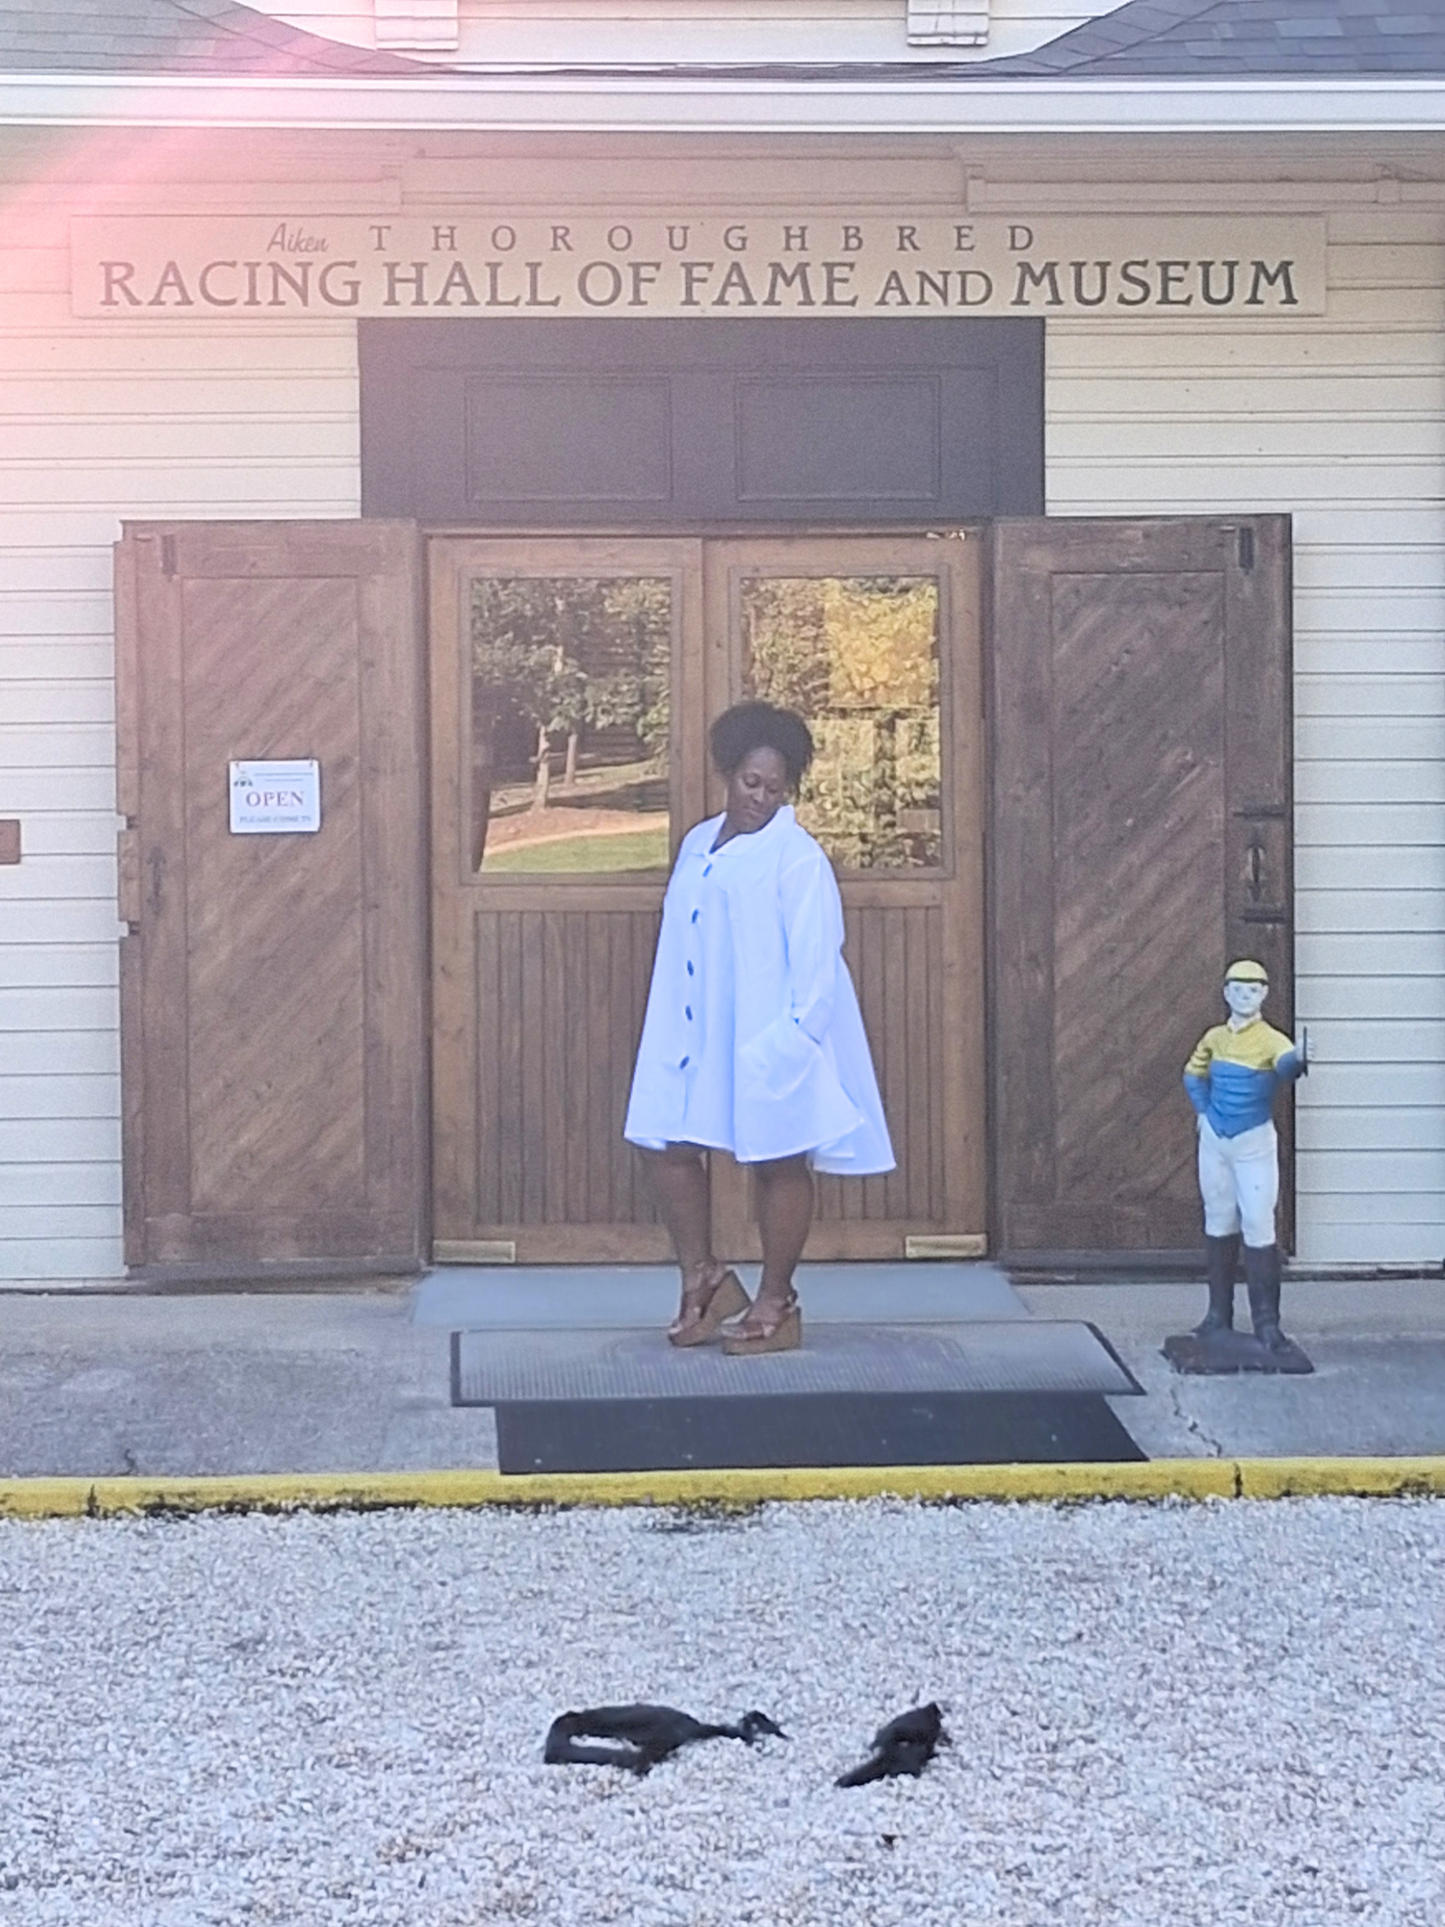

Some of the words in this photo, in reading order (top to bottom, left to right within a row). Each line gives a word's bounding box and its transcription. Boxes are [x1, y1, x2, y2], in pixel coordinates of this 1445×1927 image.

[267, 222, 329, 254] Aiken
[370, 225, 1034, 252] THOROUGHBRED
[100, 261, 361, 308] RACING
[383, 260, 560, 307] HALL
[577, 260, 662, 307] OF
[680, 260, 858, 307] FAME
[875, 270, 993, 307] AND
[1011, 259, 1299, 306] MUSEUM
[245, 790, 304, 808] OPEN
